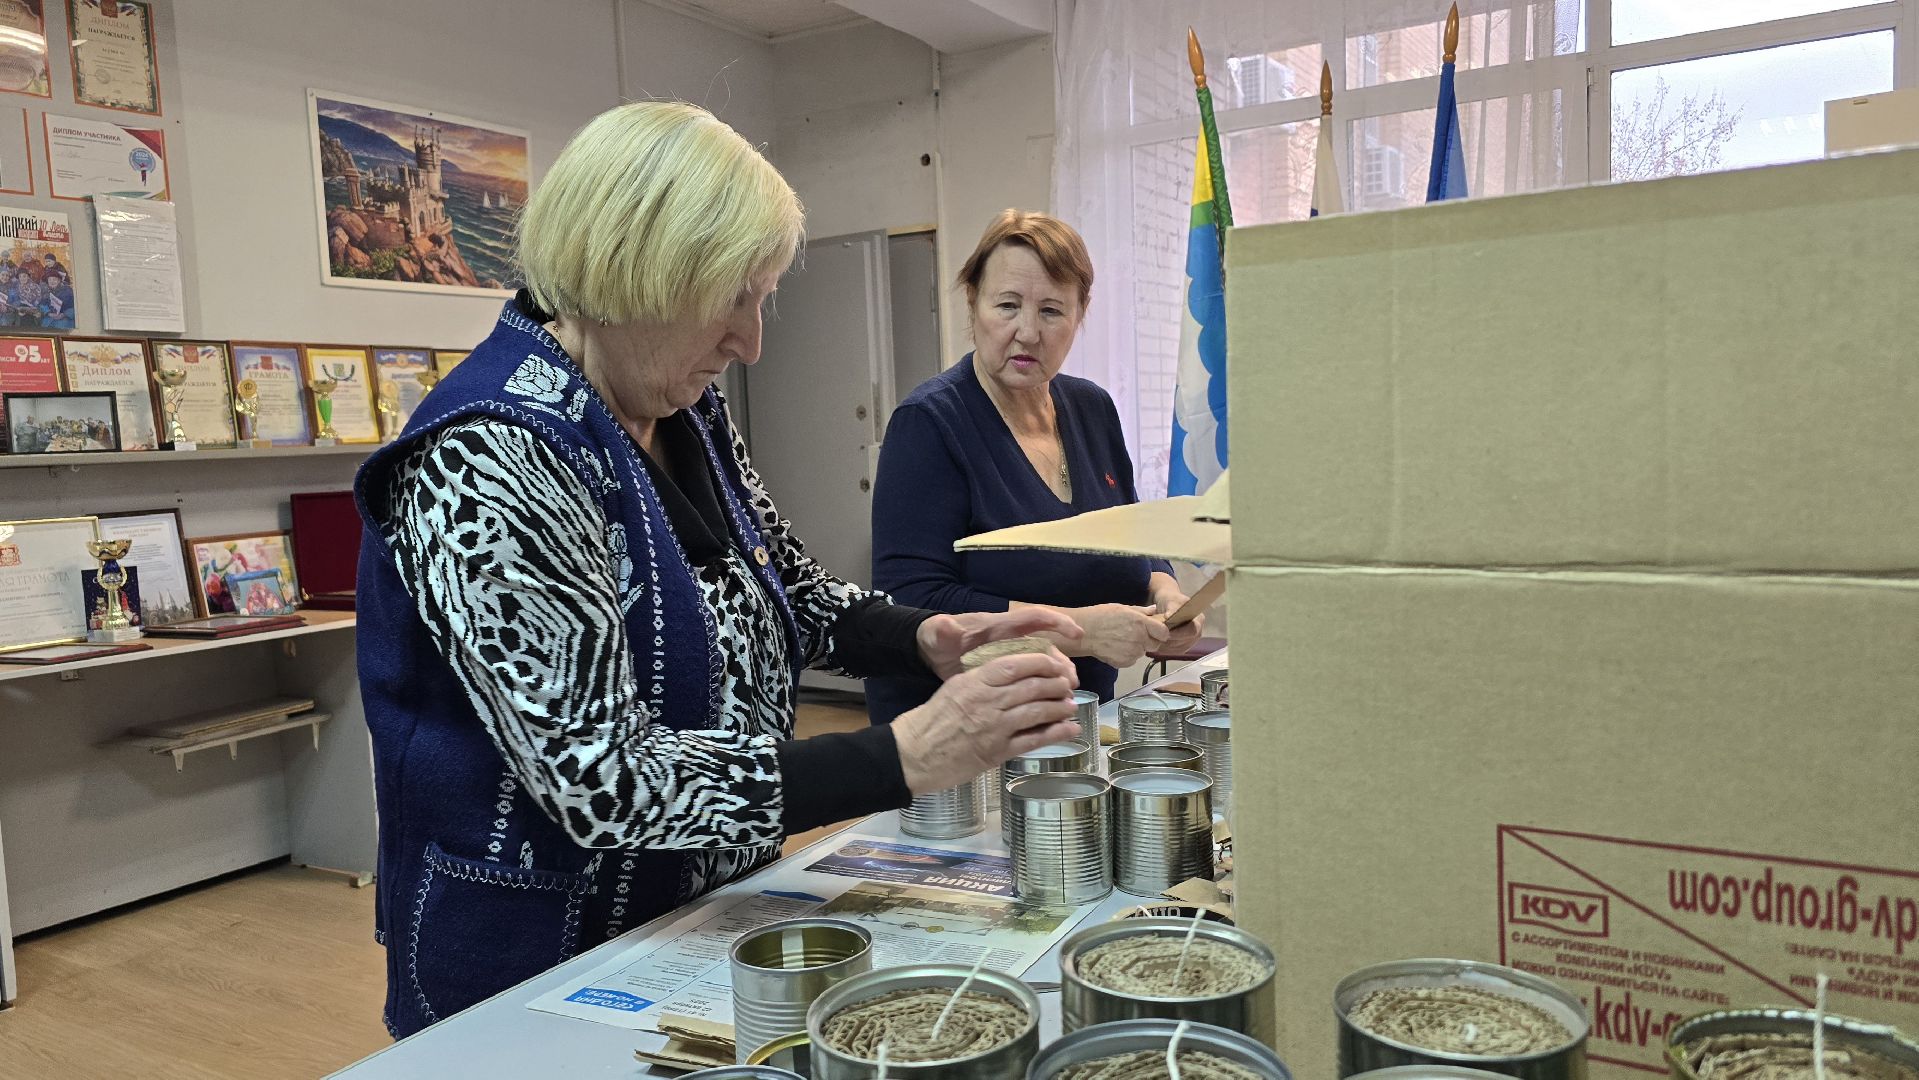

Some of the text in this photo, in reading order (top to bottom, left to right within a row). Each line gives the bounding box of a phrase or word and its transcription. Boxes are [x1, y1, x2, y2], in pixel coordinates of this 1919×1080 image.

[52, 127, 83, 136] ДИПЛОМ
[84, 131, 121, 142] УЧАСТНИКА
[15, 344, 41, 363] 95
[922, 876, 1005, 892] АКЦИЯ
[1521, 894, 1598, 923] KDV
[1511, 931, 1521, 942] С
[1523, 933, 1629, 958] АССОРТИМЕНТОМ
[1643, 952, 1725, 974] НОВИНКАМИ
[1555, 953, 1625, 973] КОМПАНИИ
[1511, 959, 1556, 976] МОЖНО
[1558, 967, 1659, 994] ОЗНАКОМИТЬСЯ
[1661, 985, 1679, 998] НА
[573, 996, 634, 1009] СЕГОДНЯ
